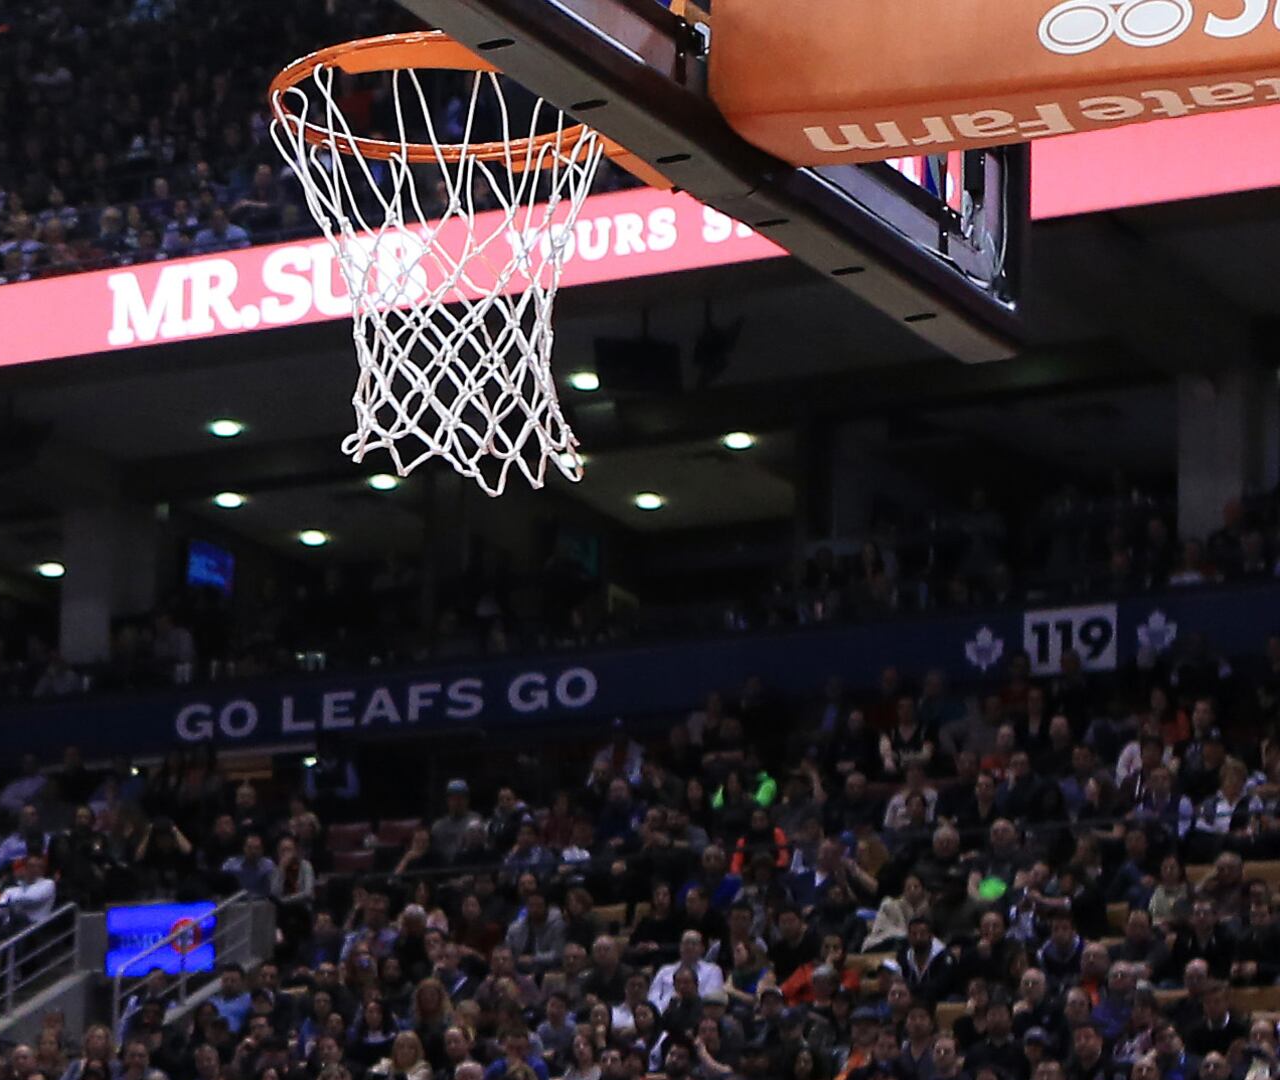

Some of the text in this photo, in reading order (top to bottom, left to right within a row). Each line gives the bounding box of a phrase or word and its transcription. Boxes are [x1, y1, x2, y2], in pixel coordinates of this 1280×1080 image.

[1032, 617, 1113, 663] 119
[175, 667, 598, 742] GO LEAFS GO
